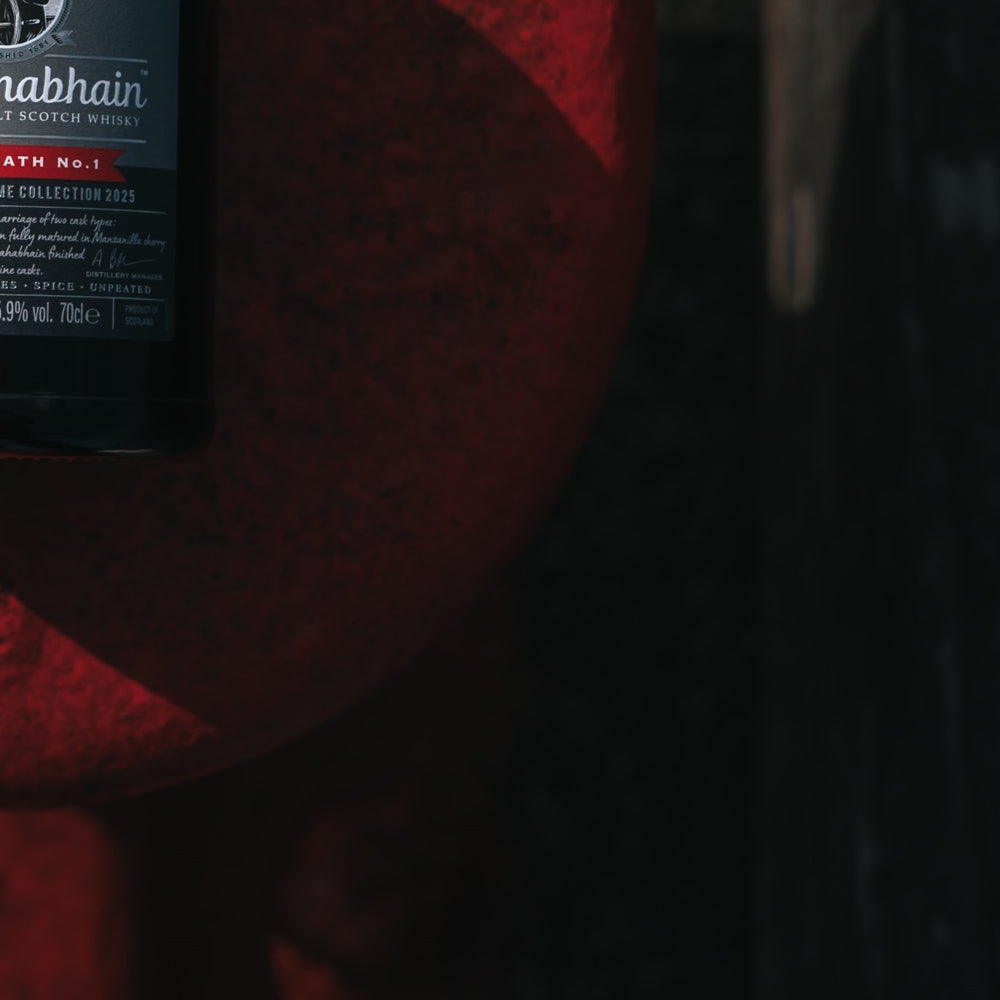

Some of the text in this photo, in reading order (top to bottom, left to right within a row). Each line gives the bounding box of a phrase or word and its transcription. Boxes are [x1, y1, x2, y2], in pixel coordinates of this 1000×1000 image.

[19, 111, 81, 124] SCOTCH
[87, 113, 141, 128] WHISKY
[57, 157, 101, 170] No.1
[19, 185, 100, 202] COLLECTION
[105, 188, 136, 203] 2025
[39, 211, 50, 226] of
[50, 212, 68, 225] two
[69, 214, 89, 226] cask
[8, 228, 36, 247] fully
[38, 230, 80, 243] matured
[80, 231, 91, 243] in
[47, 245, 86, 260] finished
[16, 264, 44, 277] casks.
[86, 271, 130, 280] DISTILLERY
[33, 282, 75, 292] SPICE
[89, 282, 152, 294] UNPEATED
[32, 302, 53, 324] vol.
